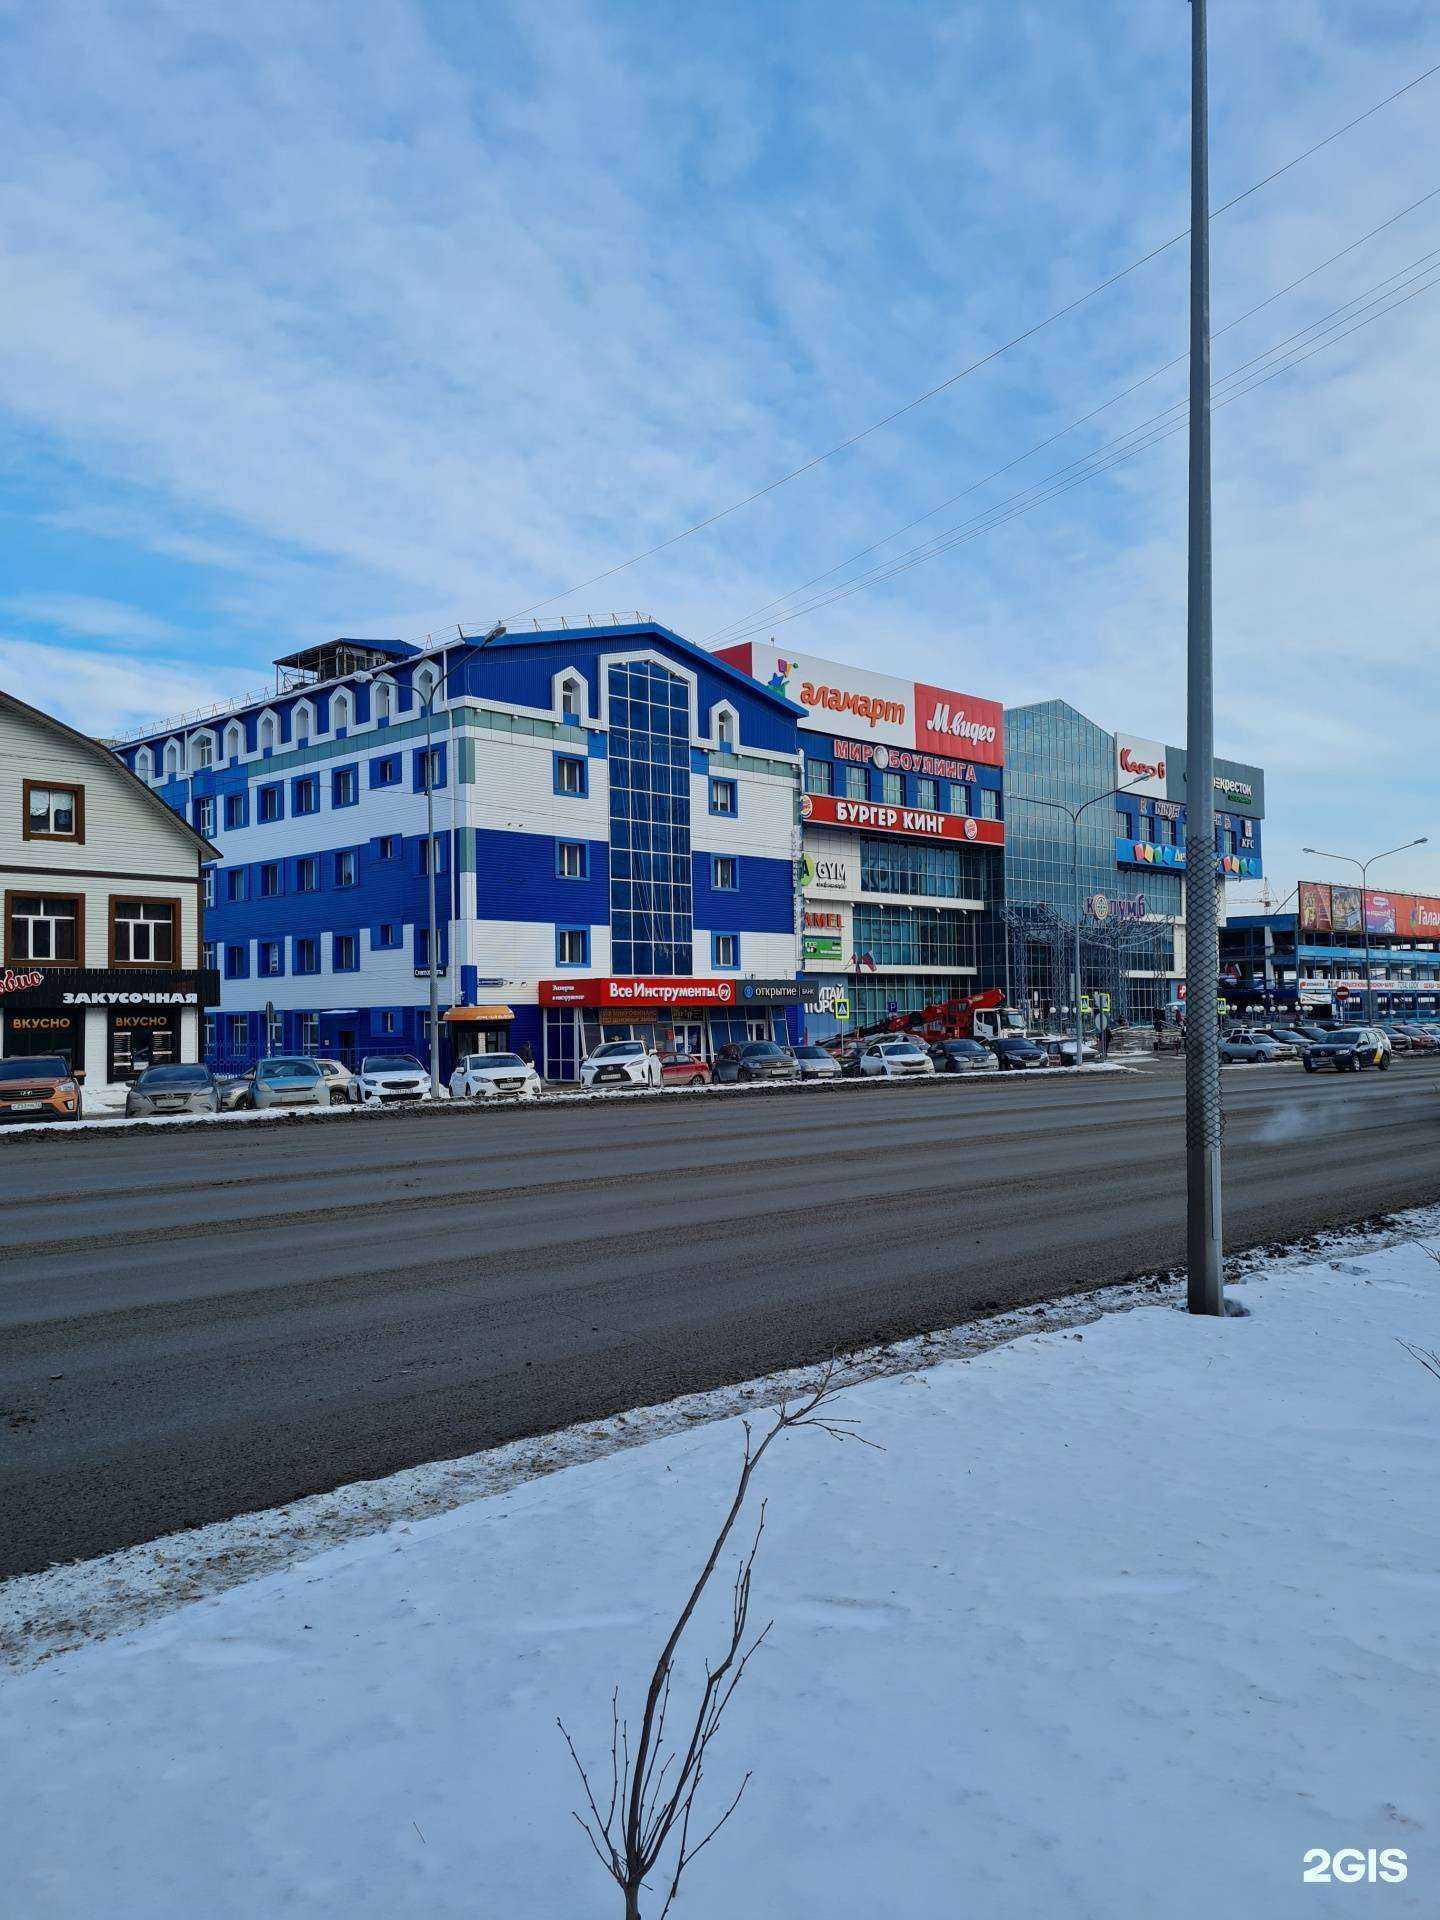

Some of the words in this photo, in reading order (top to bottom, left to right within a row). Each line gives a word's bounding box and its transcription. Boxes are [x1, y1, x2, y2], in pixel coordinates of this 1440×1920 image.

[834, 739, 873, 763] МИР
[888, 750, 977, 782] БОУЛИНГА
[836, 802, 898, 827] БУРГЕР
[903, 811, 945, 834] КИНГ
[1241, 838, 1255, 849] KFC
[1418, 905, 1440, 926] Гала
[62, 992, 198, 1004] ЗАКУСОЧНАЯ
[755, 986, 797, 999] открытие
[12, 1017, 71, 1029] ВКУСНО
[115, 1016, 167, 1027] ВКУСНО
